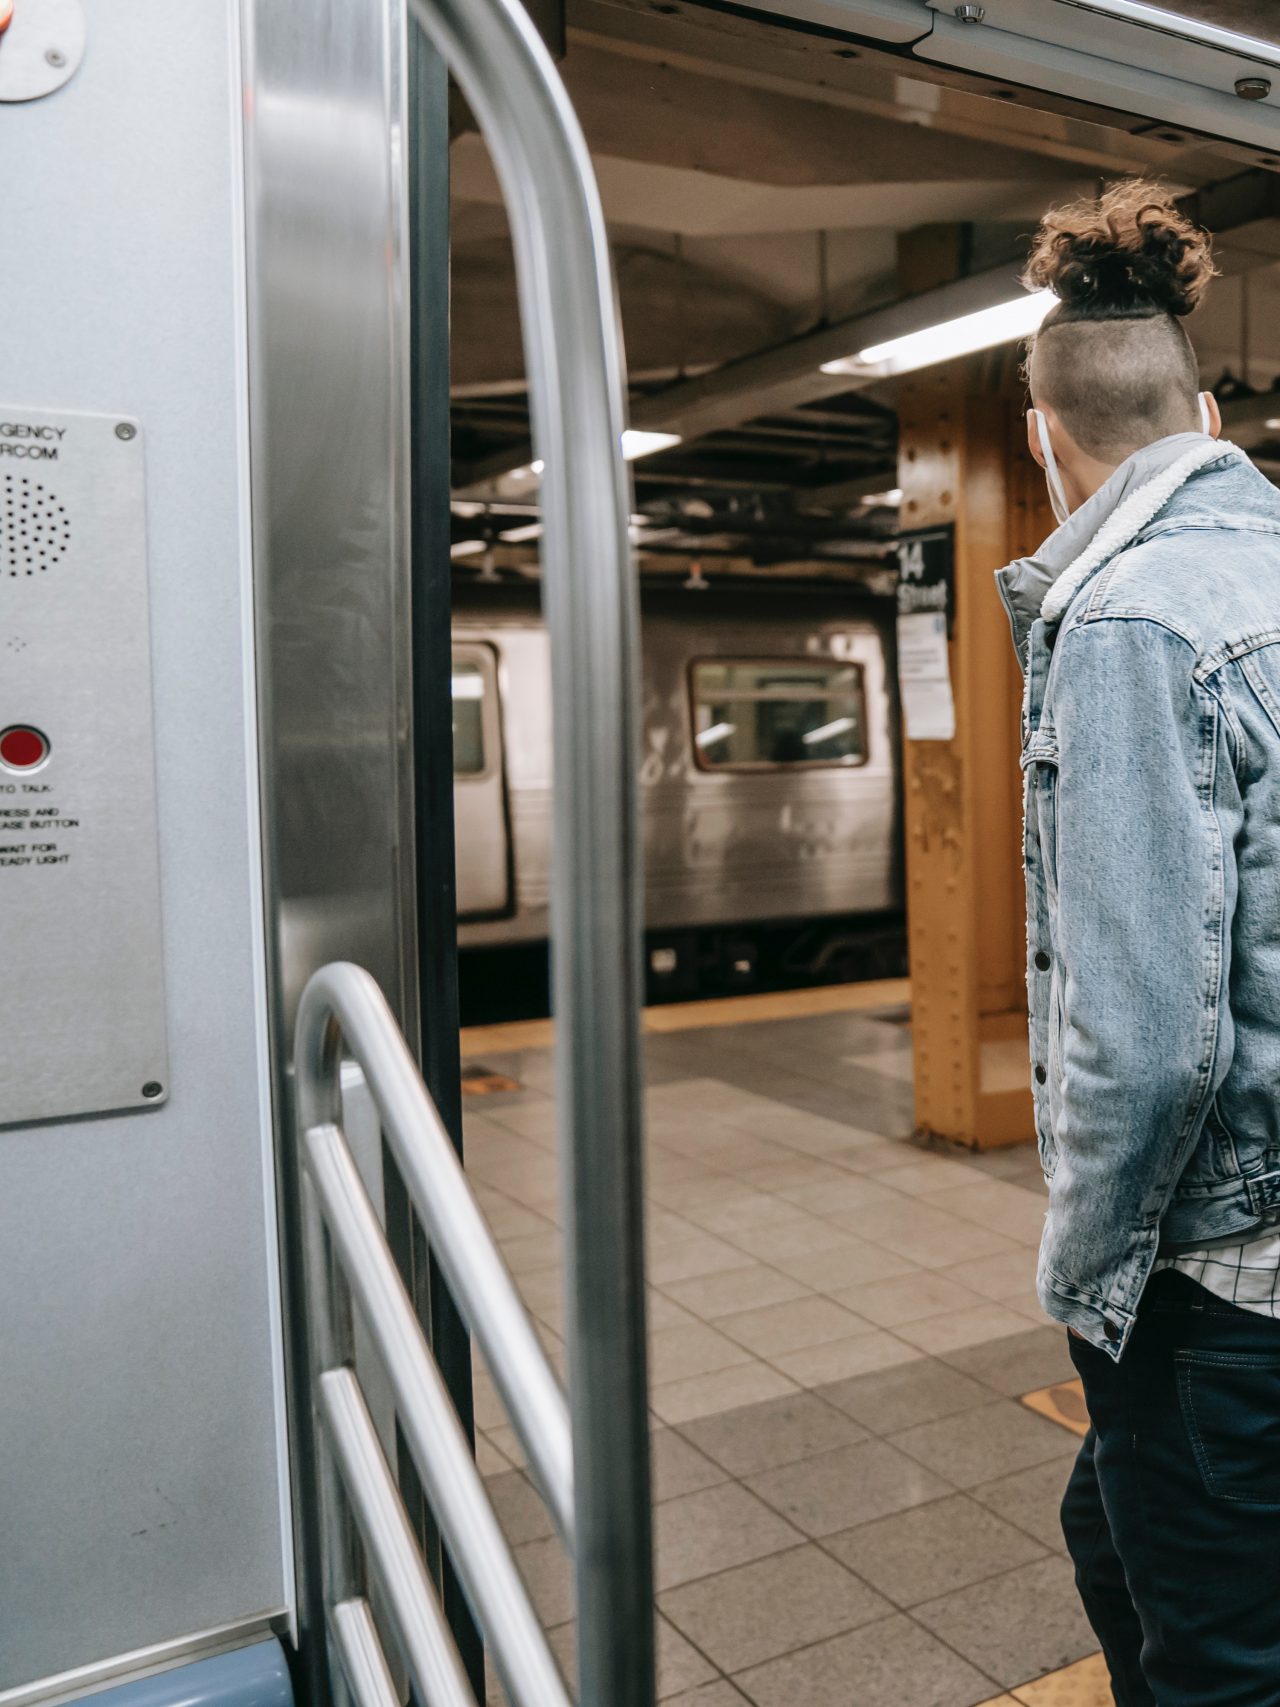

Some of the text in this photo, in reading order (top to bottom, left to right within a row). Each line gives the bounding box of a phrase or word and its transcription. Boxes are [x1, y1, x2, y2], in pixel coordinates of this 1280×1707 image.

[35, 807, 60, 817] AND
[29, 819, 80, 829] BUTTON
[32, 843, 57, 852] FOR
[37, 854, 70, 865] LIGHT
